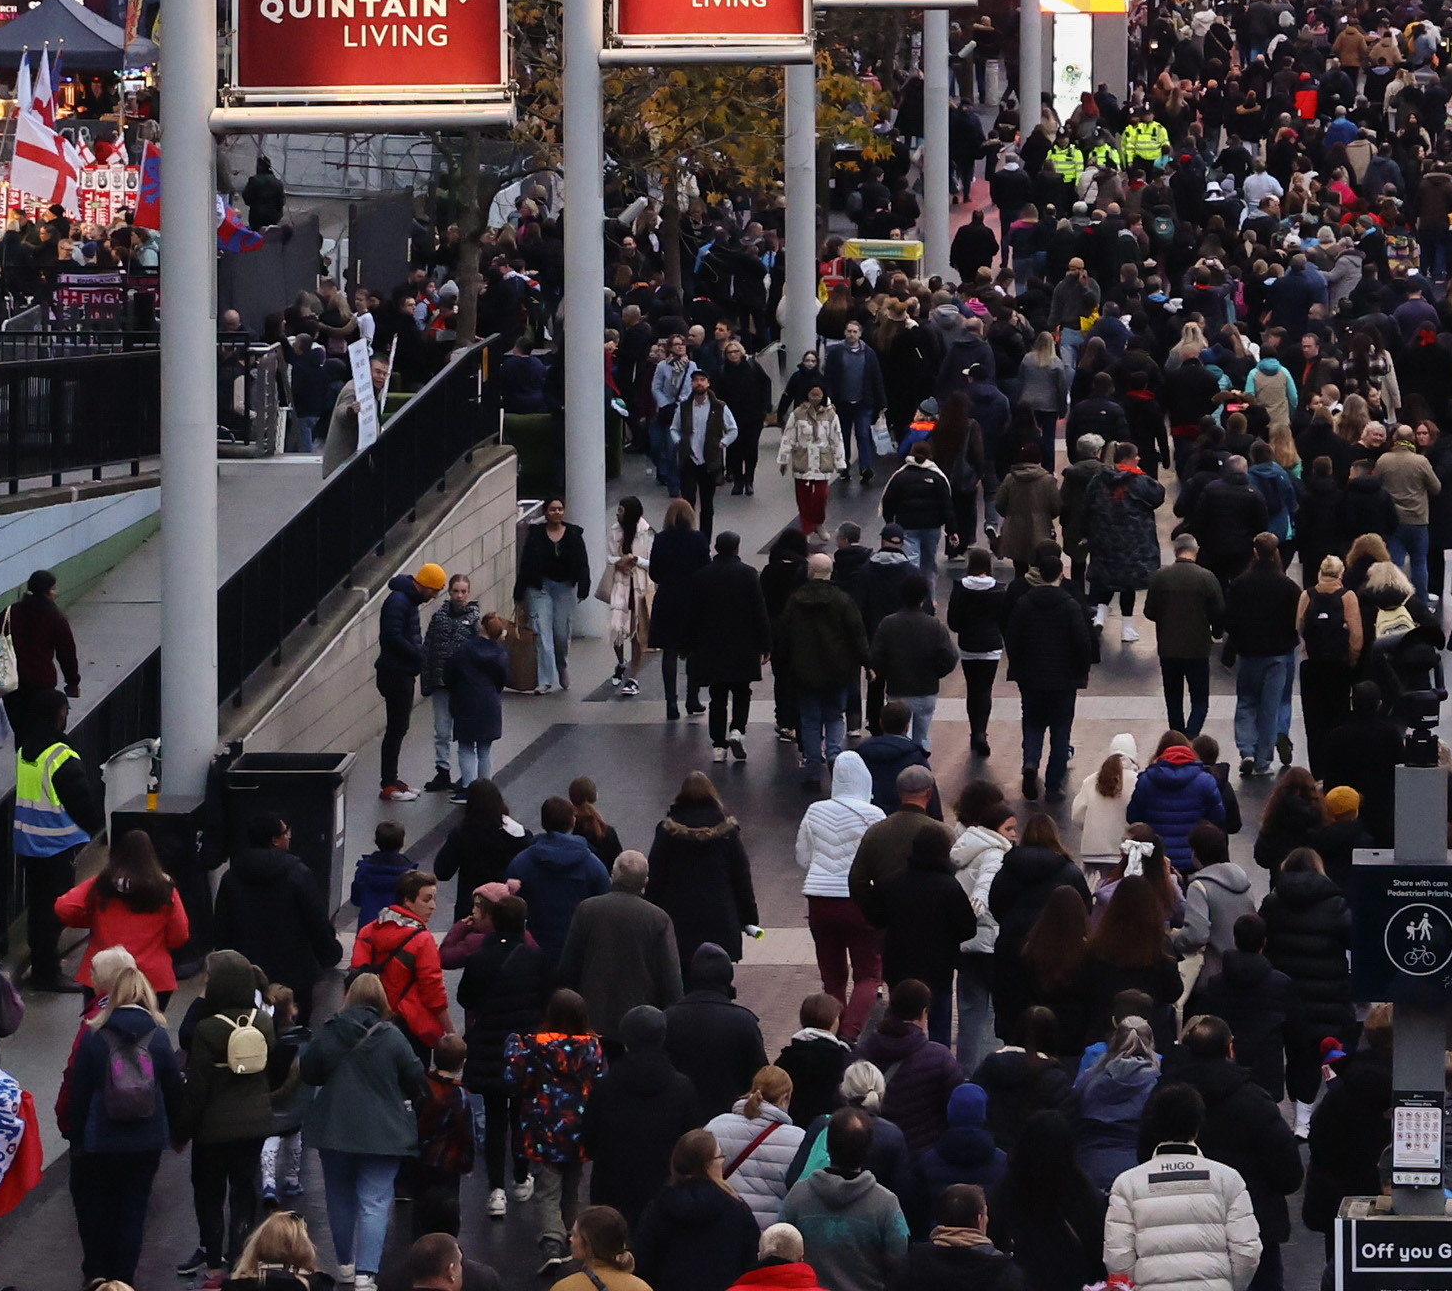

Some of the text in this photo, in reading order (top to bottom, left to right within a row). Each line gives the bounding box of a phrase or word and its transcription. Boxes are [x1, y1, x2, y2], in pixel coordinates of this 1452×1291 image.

[345, 24, 448, 47] LIVING
[1393, 879, 1414, 887] Share
[1415, 879, 1432, 887] with
[1387, 889, 1426, 897] Pedestrian
[1161, 1161, 1195, 1171] HUGO
[1361, 1243, 1395, 1259] Off
[1399, 1245, 1433, 1263] you
